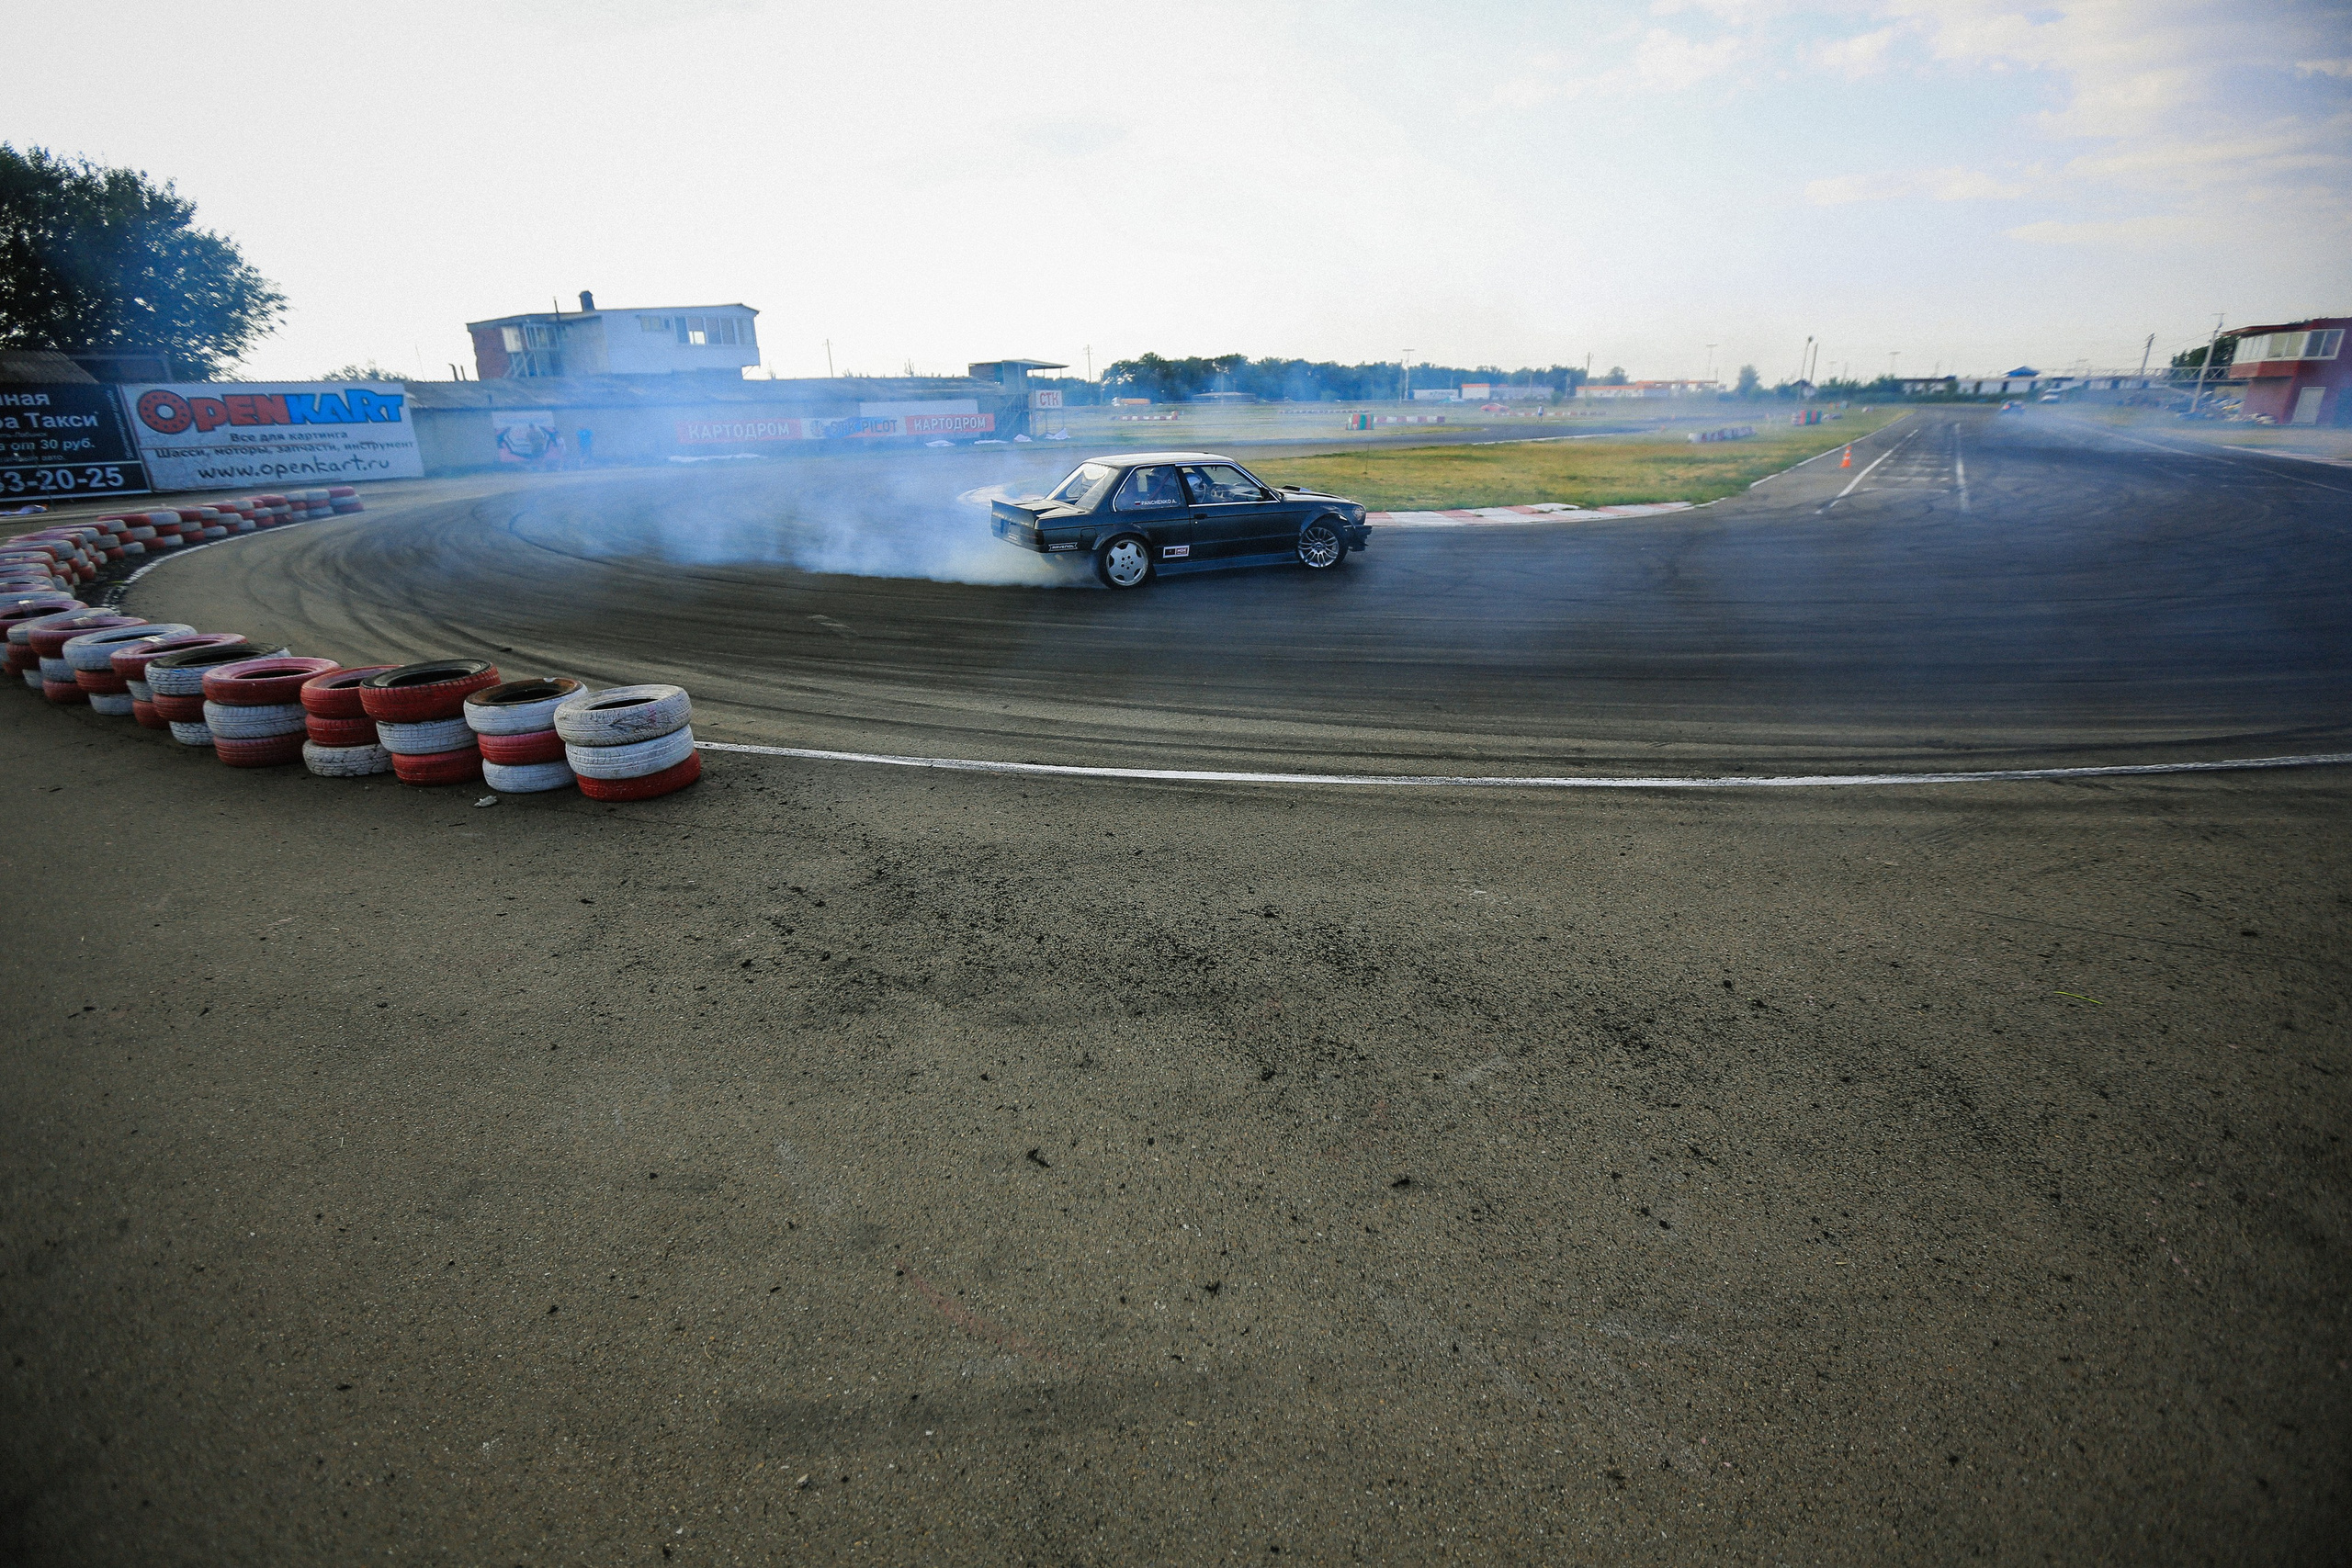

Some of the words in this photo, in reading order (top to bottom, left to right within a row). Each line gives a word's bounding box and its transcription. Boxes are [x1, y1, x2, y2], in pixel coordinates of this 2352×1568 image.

[23, 412, 99, 429] Такси
[830, 420, 856, 434] STK
[862, 419, 898, 434] PILOT
[914, 416, 986, 432] КАРТОДРОМ
[231, 433, 256, 443] Все
[260, 433, 286, 444] для
[288, 430, 349, 443] картинга
[689, 422, 790, 440] КАРТОДРОМ
[40, 438, 59, 450] 30
[62, 437, 96, 452] руб.
[154, 447, 211, 459] Шасси,
[214, 446, 274, 457] моторы,
[344, 441, 413, 452] инструмент
[198, 454, 390, 479] www.openkart.ru
